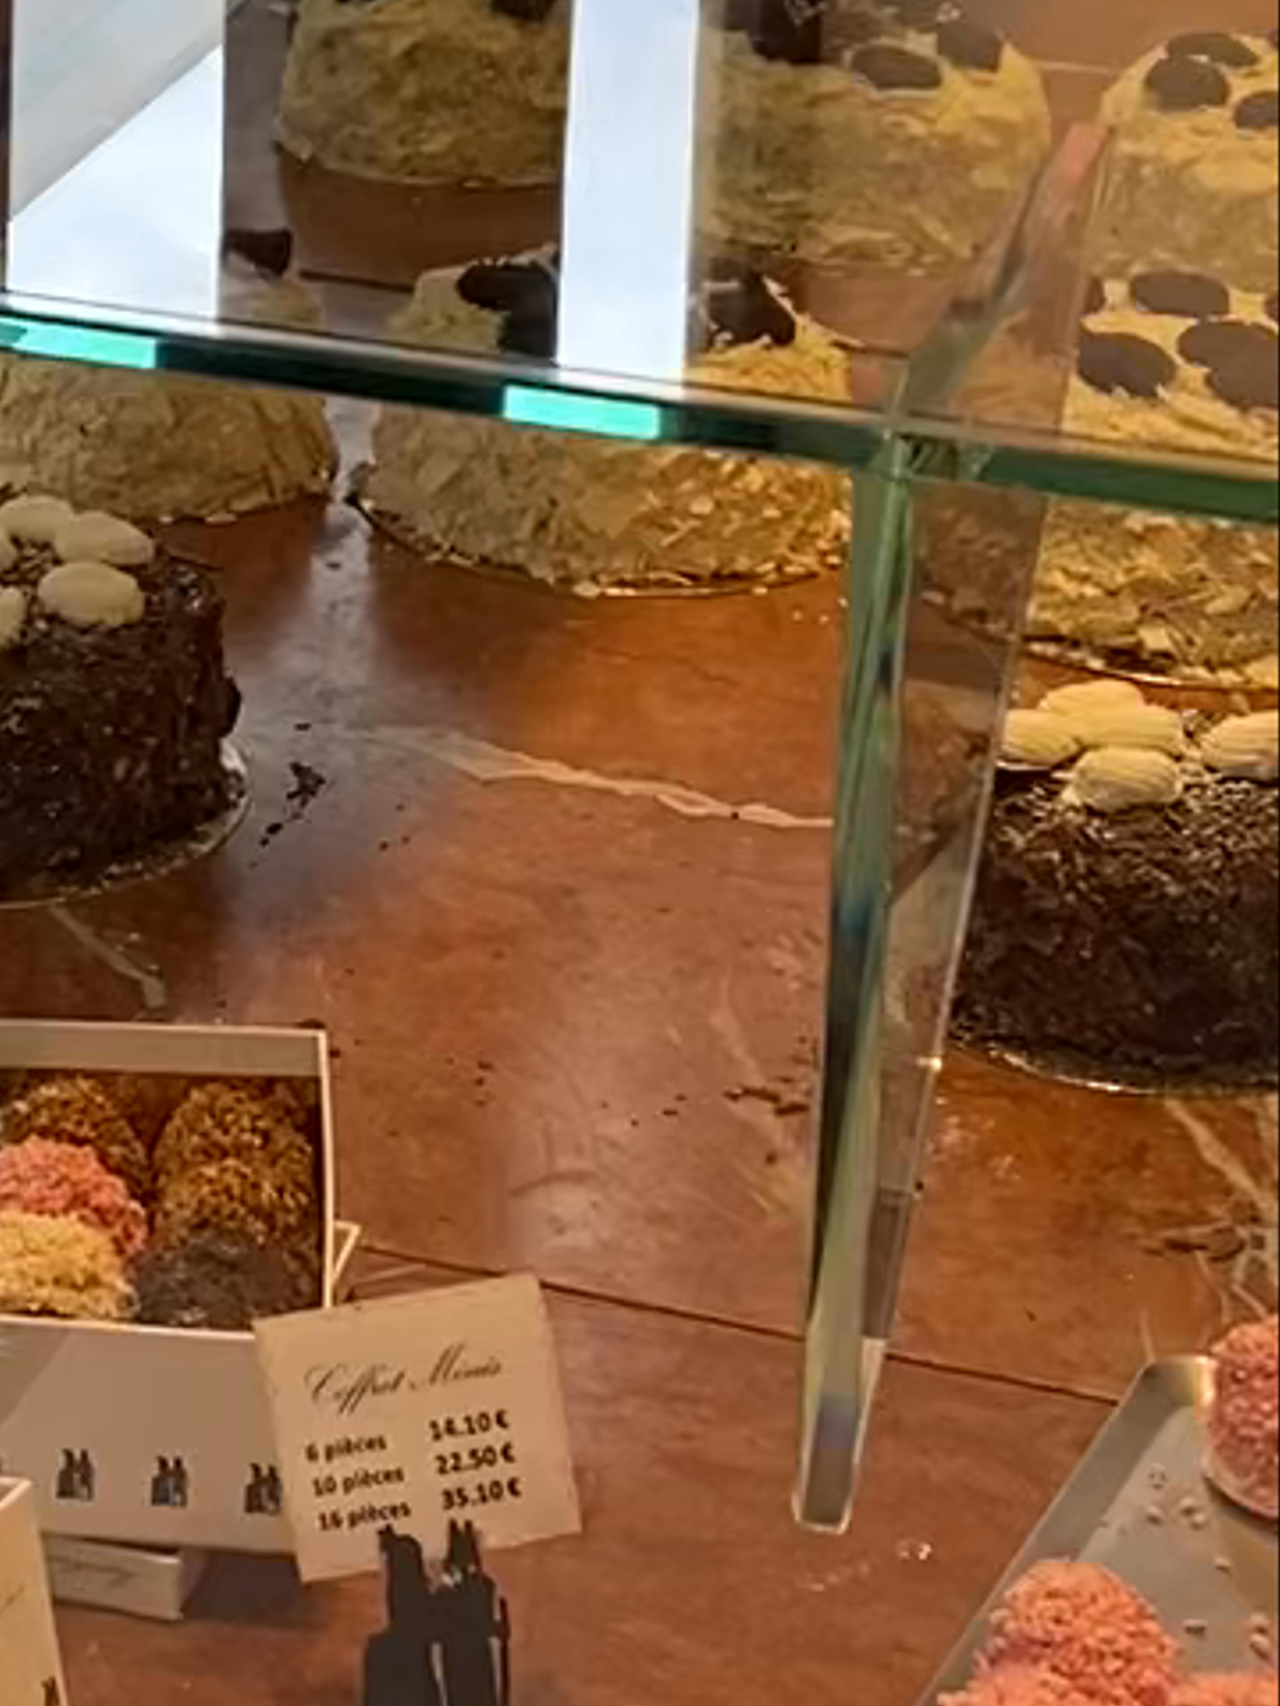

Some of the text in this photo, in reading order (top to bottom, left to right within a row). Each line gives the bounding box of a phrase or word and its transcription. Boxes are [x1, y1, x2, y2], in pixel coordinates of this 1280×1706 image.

[304, 1363, 406, 1415] Coffret
[306, 1444, 319, 1462] 6
[325, 1435, 387, 1462] pièces
[312, 1476, 336, 1496] 10
[343, 1467, 404, 1494] pièces
[348, 1501, 411, 1529] pièces
